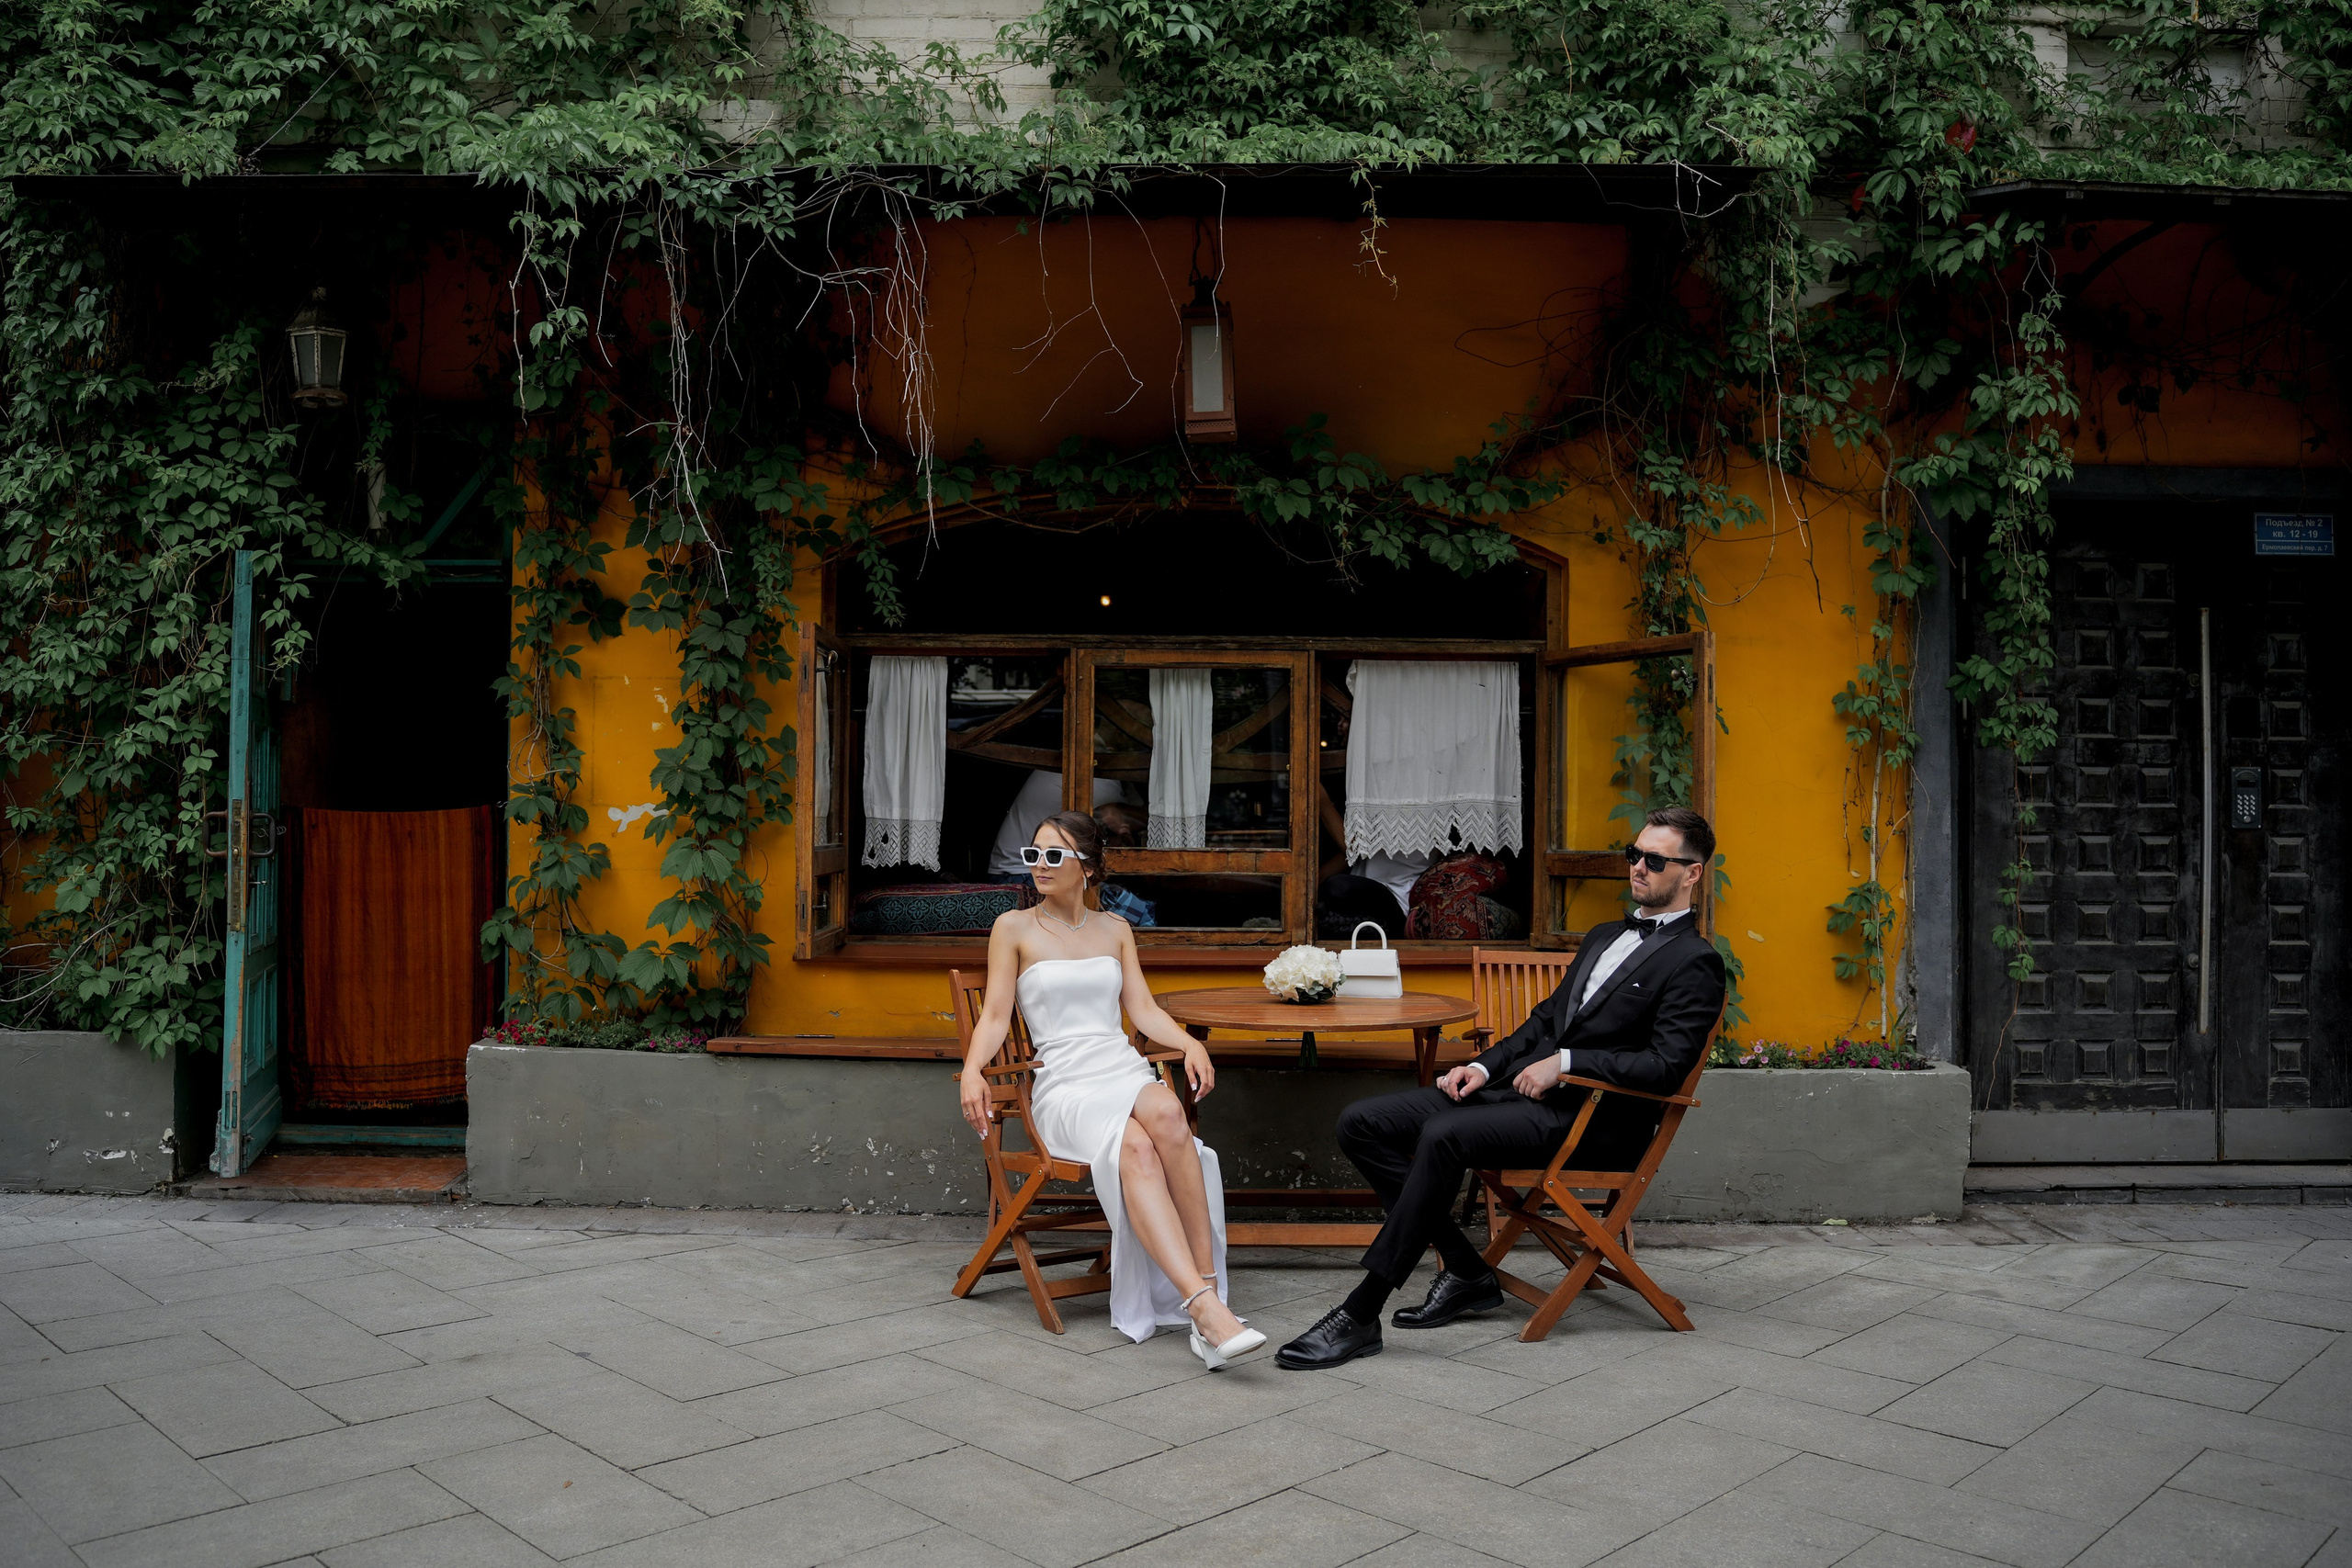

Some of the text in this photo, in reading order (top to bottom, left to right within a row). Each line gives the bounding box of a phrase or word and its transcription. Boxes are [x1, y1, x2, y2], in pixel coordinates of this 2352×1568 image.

[2305, 519, 2315, 527] №
[2317, 518, 2324, 527] 2
[2290, 530, 2300, 538] 12
[2308, 530, 2318, 538] 19
